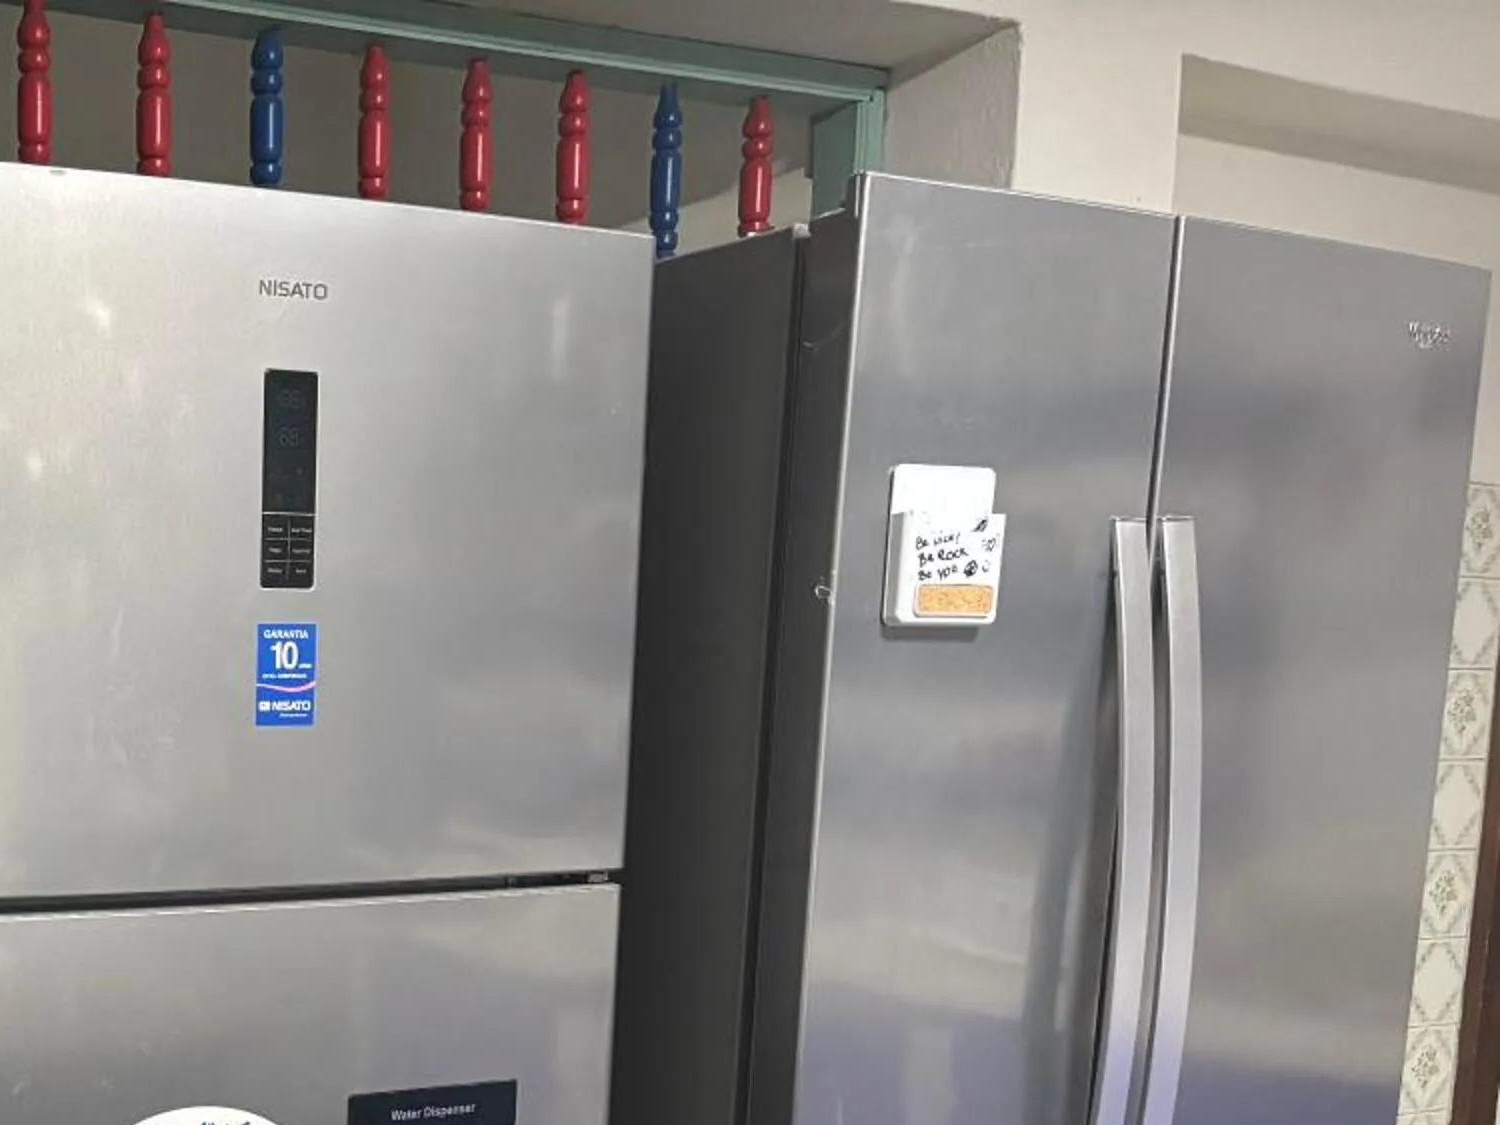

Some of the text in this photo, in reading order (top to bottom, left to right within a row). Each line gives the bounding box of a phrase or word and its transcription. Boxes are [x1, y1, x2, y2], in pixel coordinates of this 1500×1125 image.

[259, 279, 328, 301] NISATO
[270, 641, 299, 669] 10
[272, 701, 311, 712] NISATO
[391, 1103, 477, 1121] Water Dispenser
